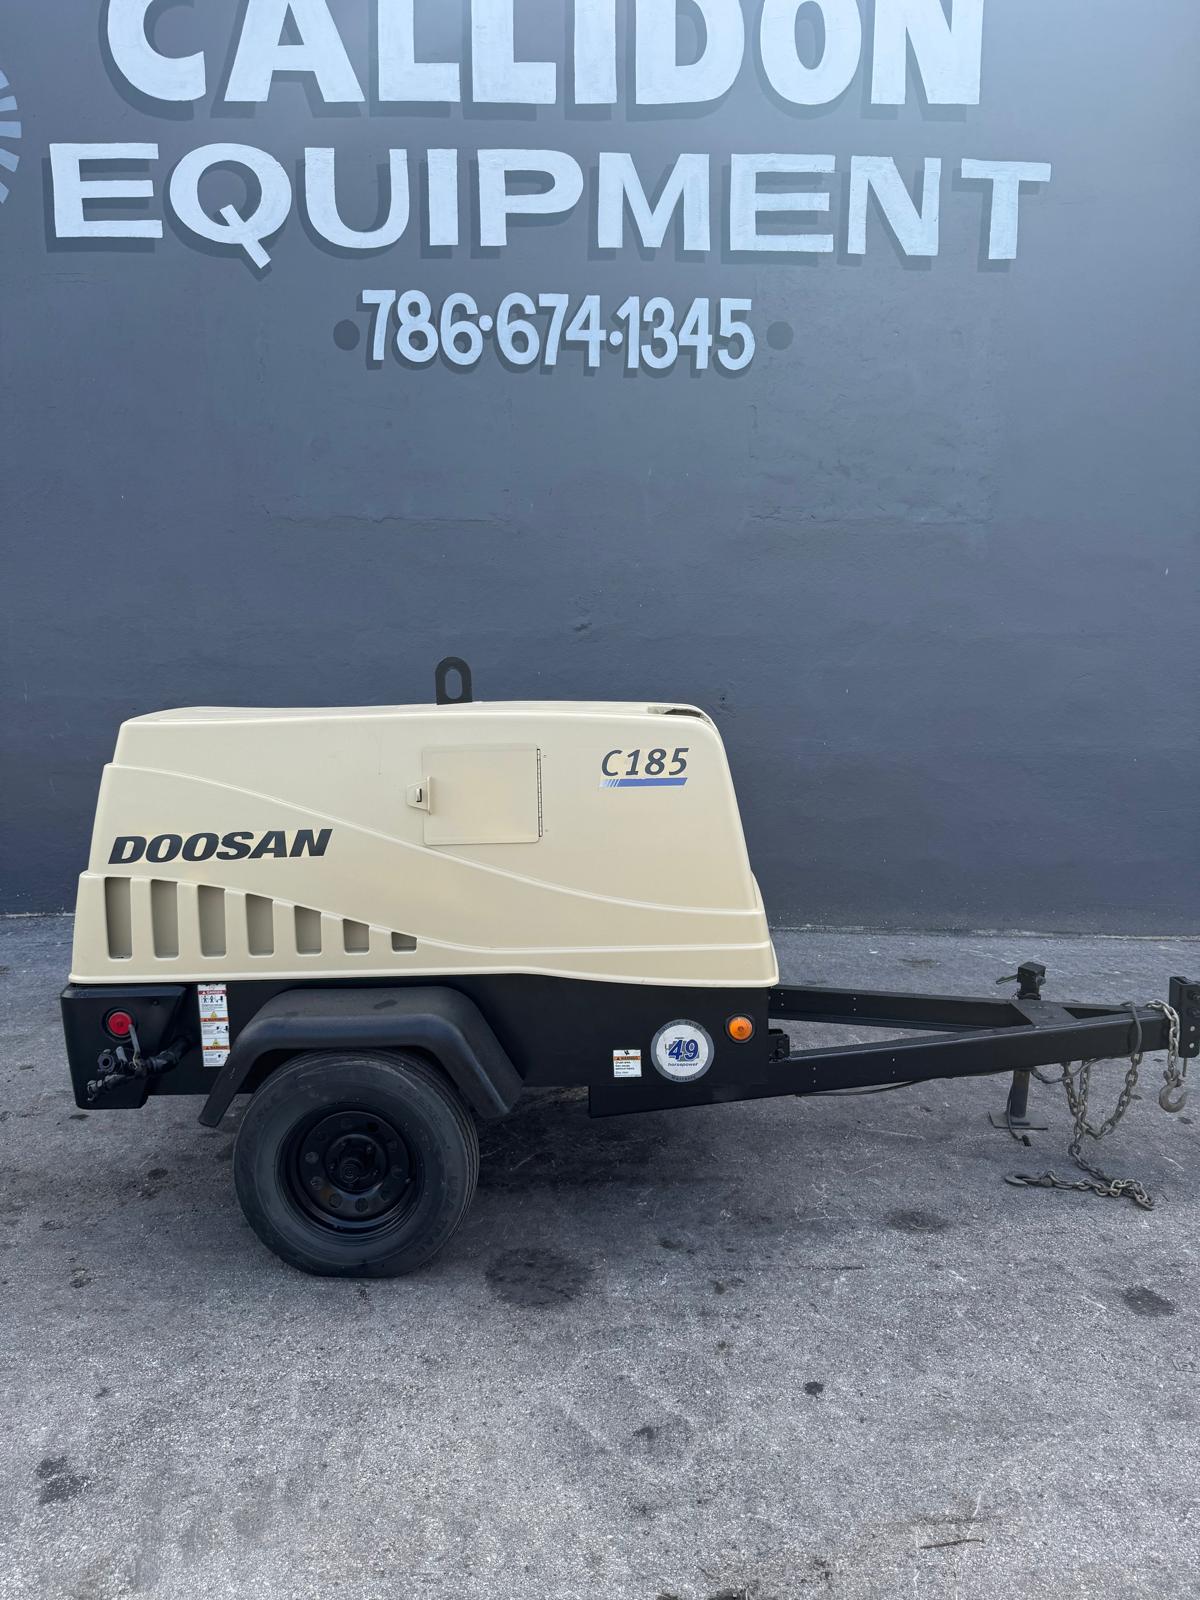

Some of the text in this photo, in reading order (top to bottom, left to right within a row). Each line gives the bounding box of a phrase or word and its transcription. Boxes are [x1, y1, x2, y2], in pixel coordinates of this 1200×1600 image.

[107, 0, 983, 104] CALLIDON
[49, 142, 1051, 269] EQUIPMENT
[601, 747, 689, 777] C185
[107, 828, 333, 865] DOOSAN
[668, 1039, 699, 1060] 49
